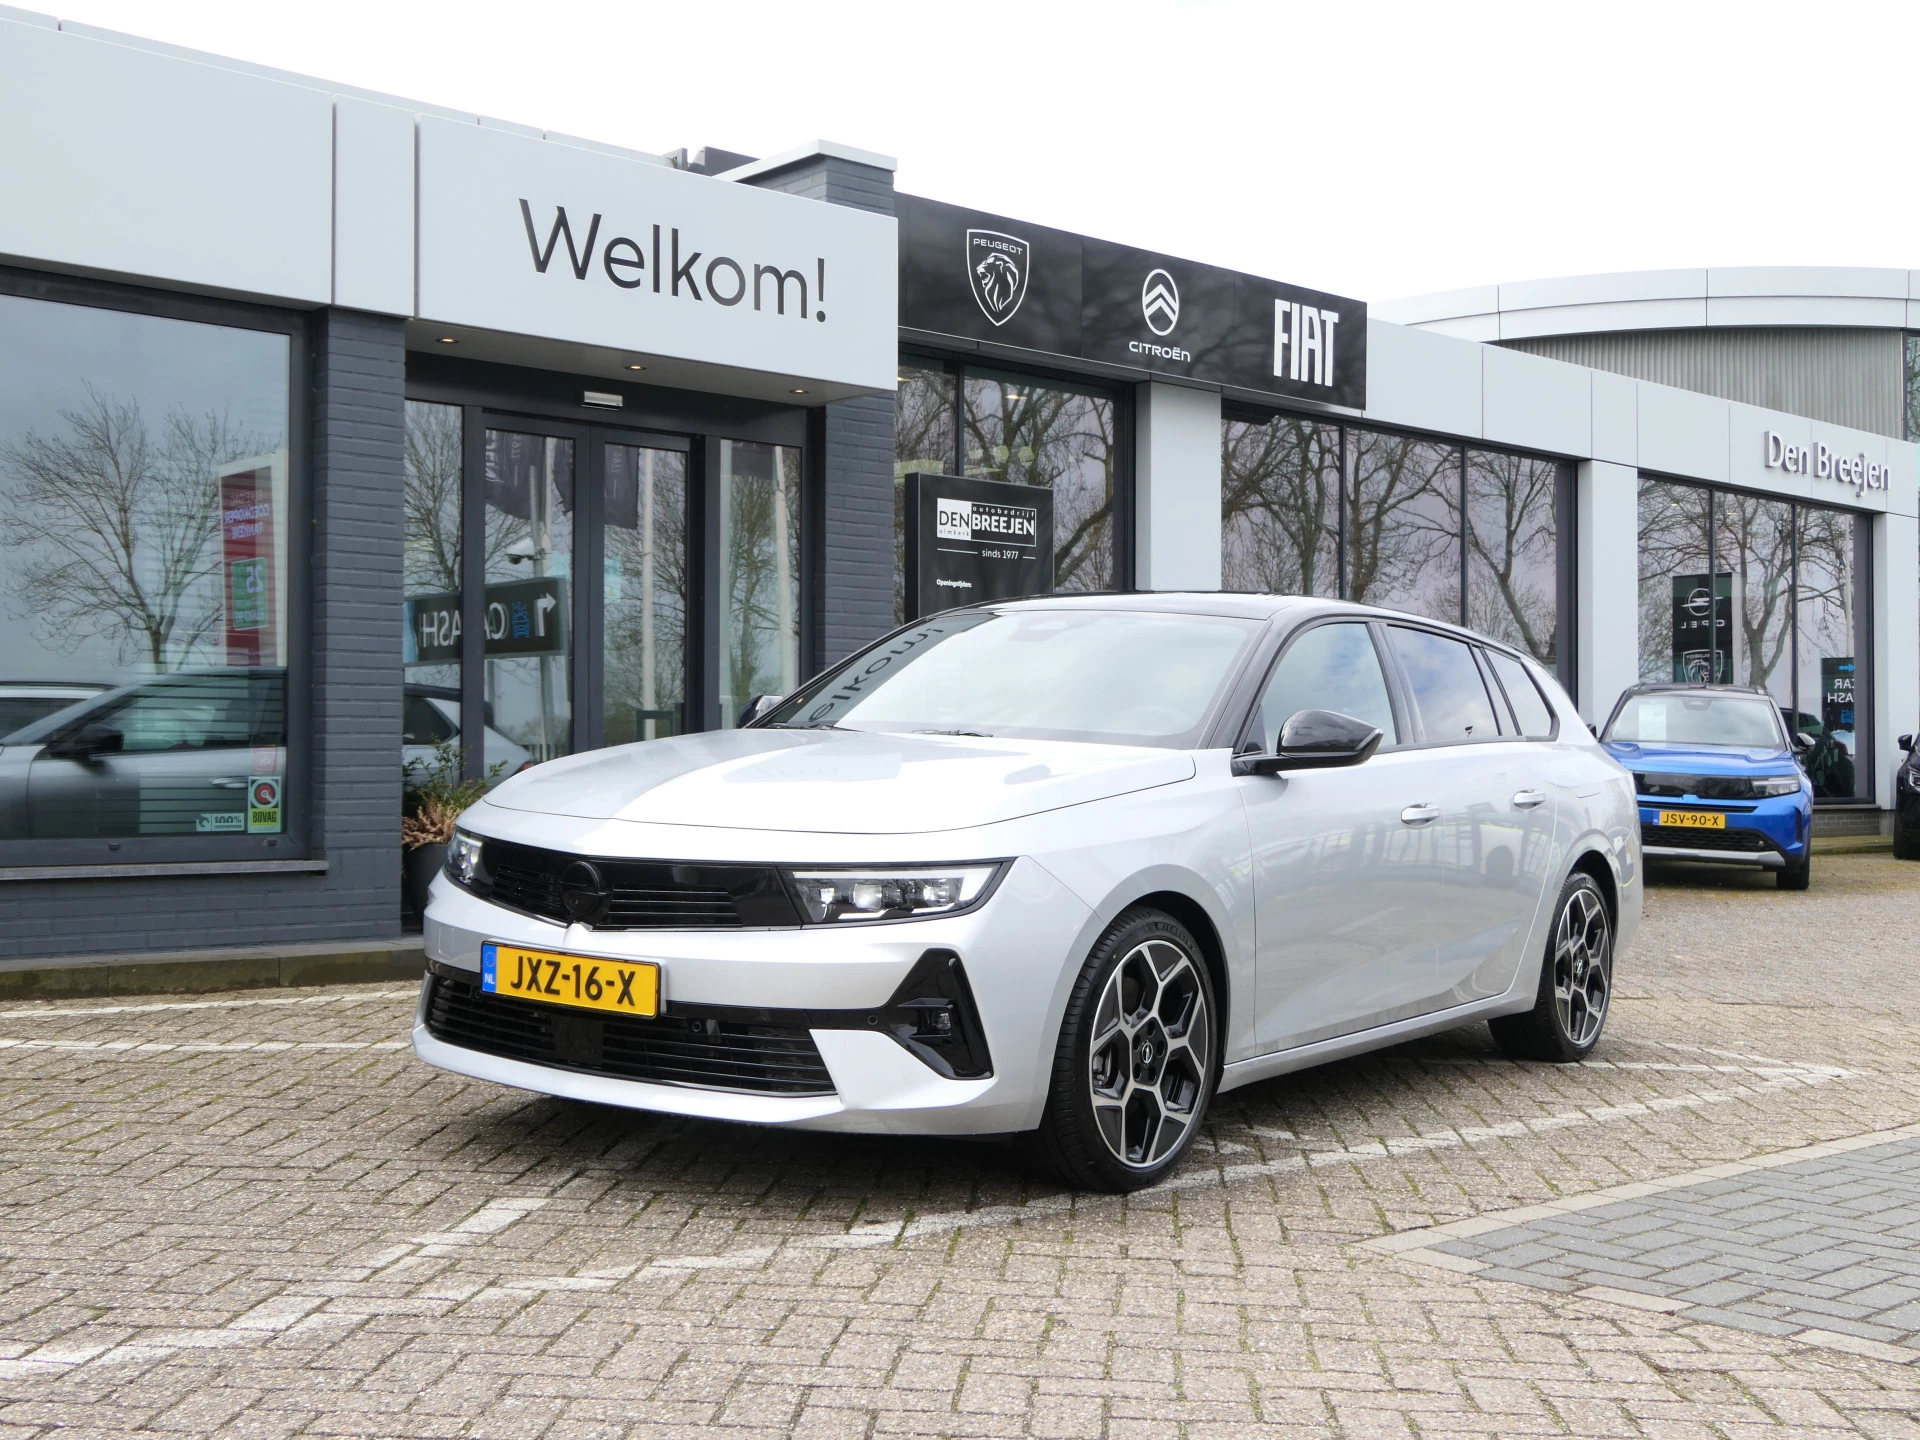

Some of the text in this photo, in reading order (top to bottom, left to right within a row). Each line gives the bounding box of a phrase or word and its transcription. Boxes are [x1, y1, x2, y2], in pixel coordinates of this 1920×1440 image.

[973, 237, 1023, 255] PEUGEOT
[518, 197, 827, 323] Welkom!
[1273, 298, 1339, 388] FIAT
[1764, 430, 1892, 497] Den Breejen
[972, 506, 1035, 518] autobedrijf
[939, 510, 1035, 536] DEN BREEJEN
[938, 529, 970, 537] almkerk
[981, 548, 1019, 560] sinds 1977
[252, 811, 277, 823] BOVAG
[1662, 813, 1719, 826] JSV-90-X
[484, 955, 636, 1007] NL JXZ-16-X
